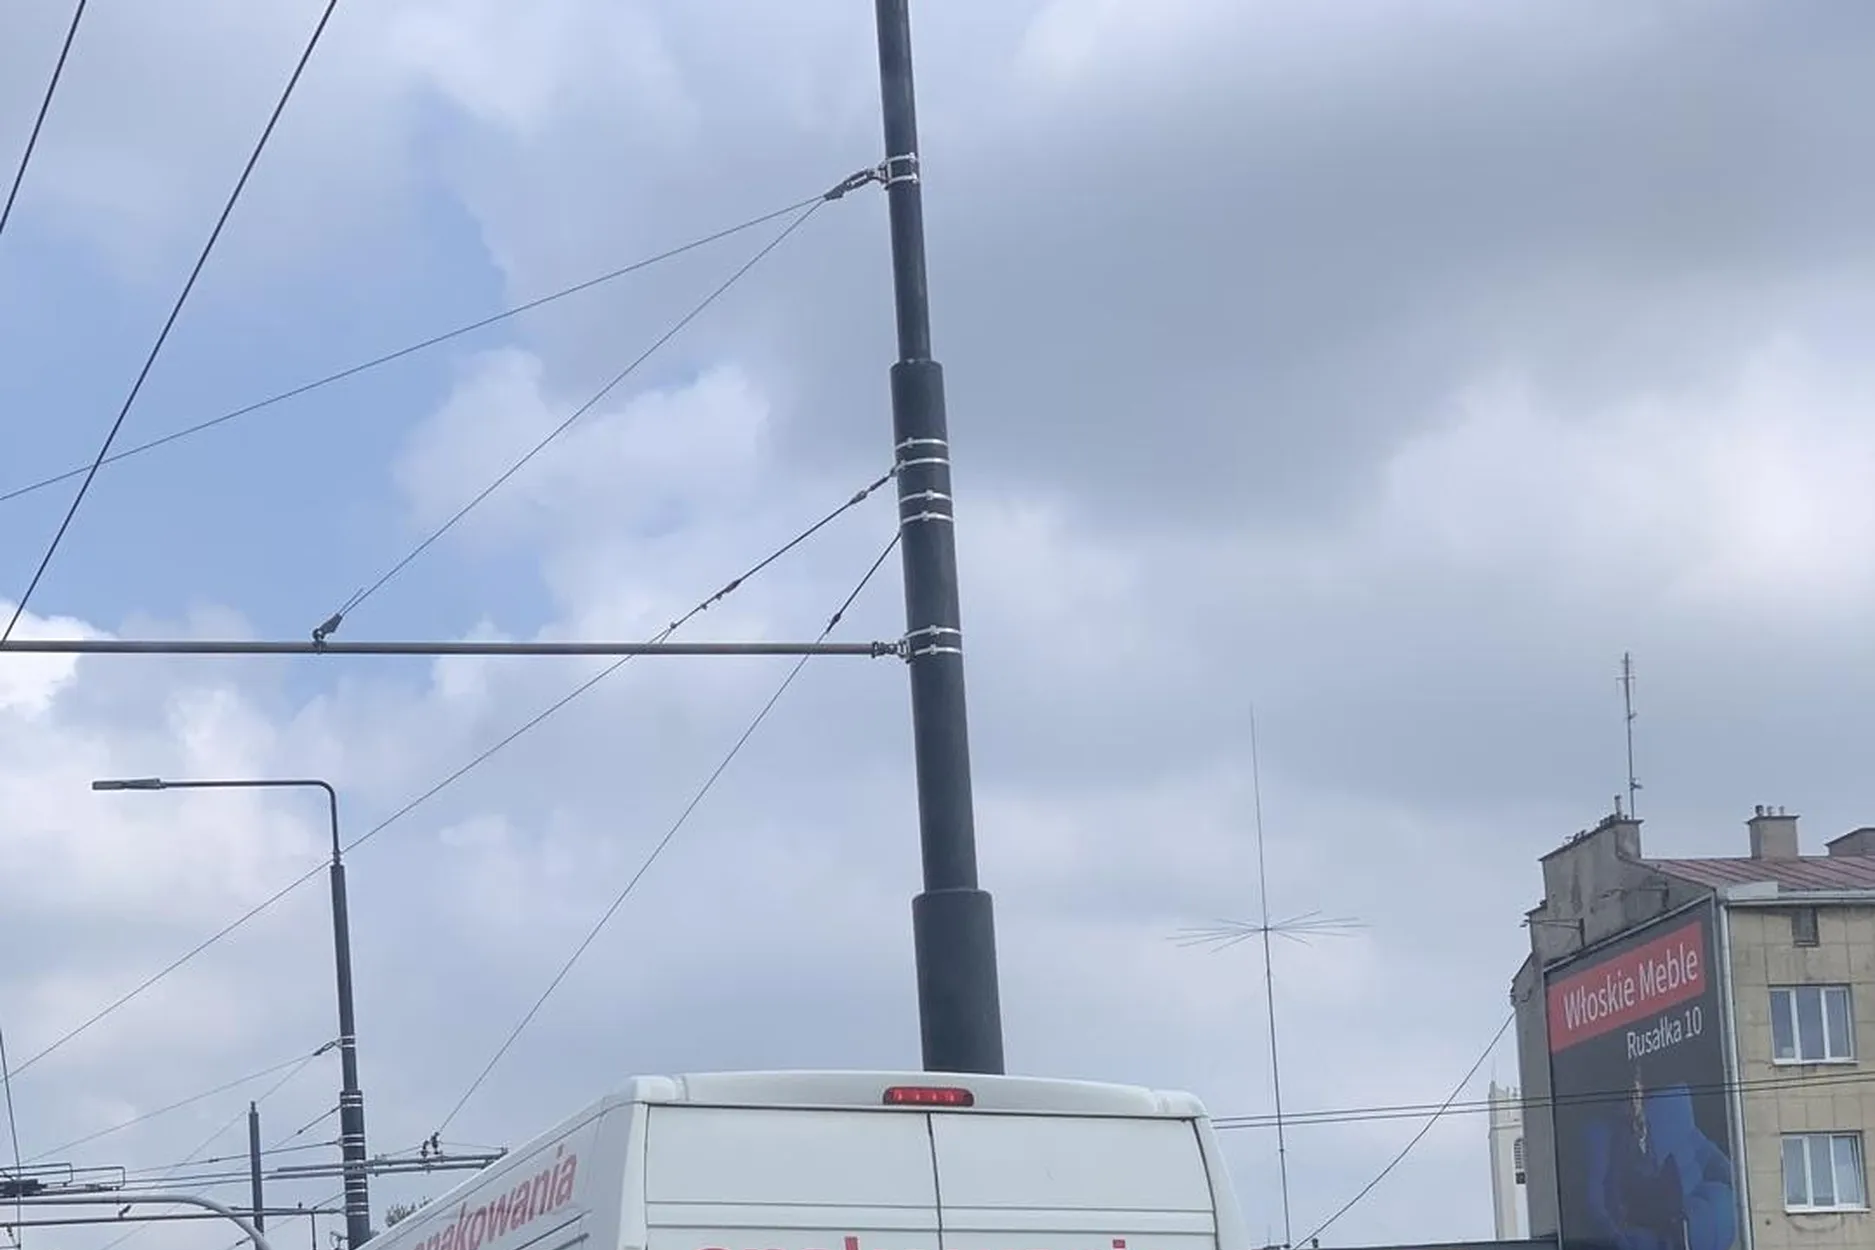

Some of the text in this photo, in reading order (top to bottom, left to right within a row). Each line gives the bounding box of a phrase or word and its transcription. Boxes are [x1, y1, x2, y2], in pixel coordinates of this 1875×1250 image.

[1563, 942, 1698, 1030] Włoskie Meble
[1627, 1006, 1702, 1060] Rusałka 10
